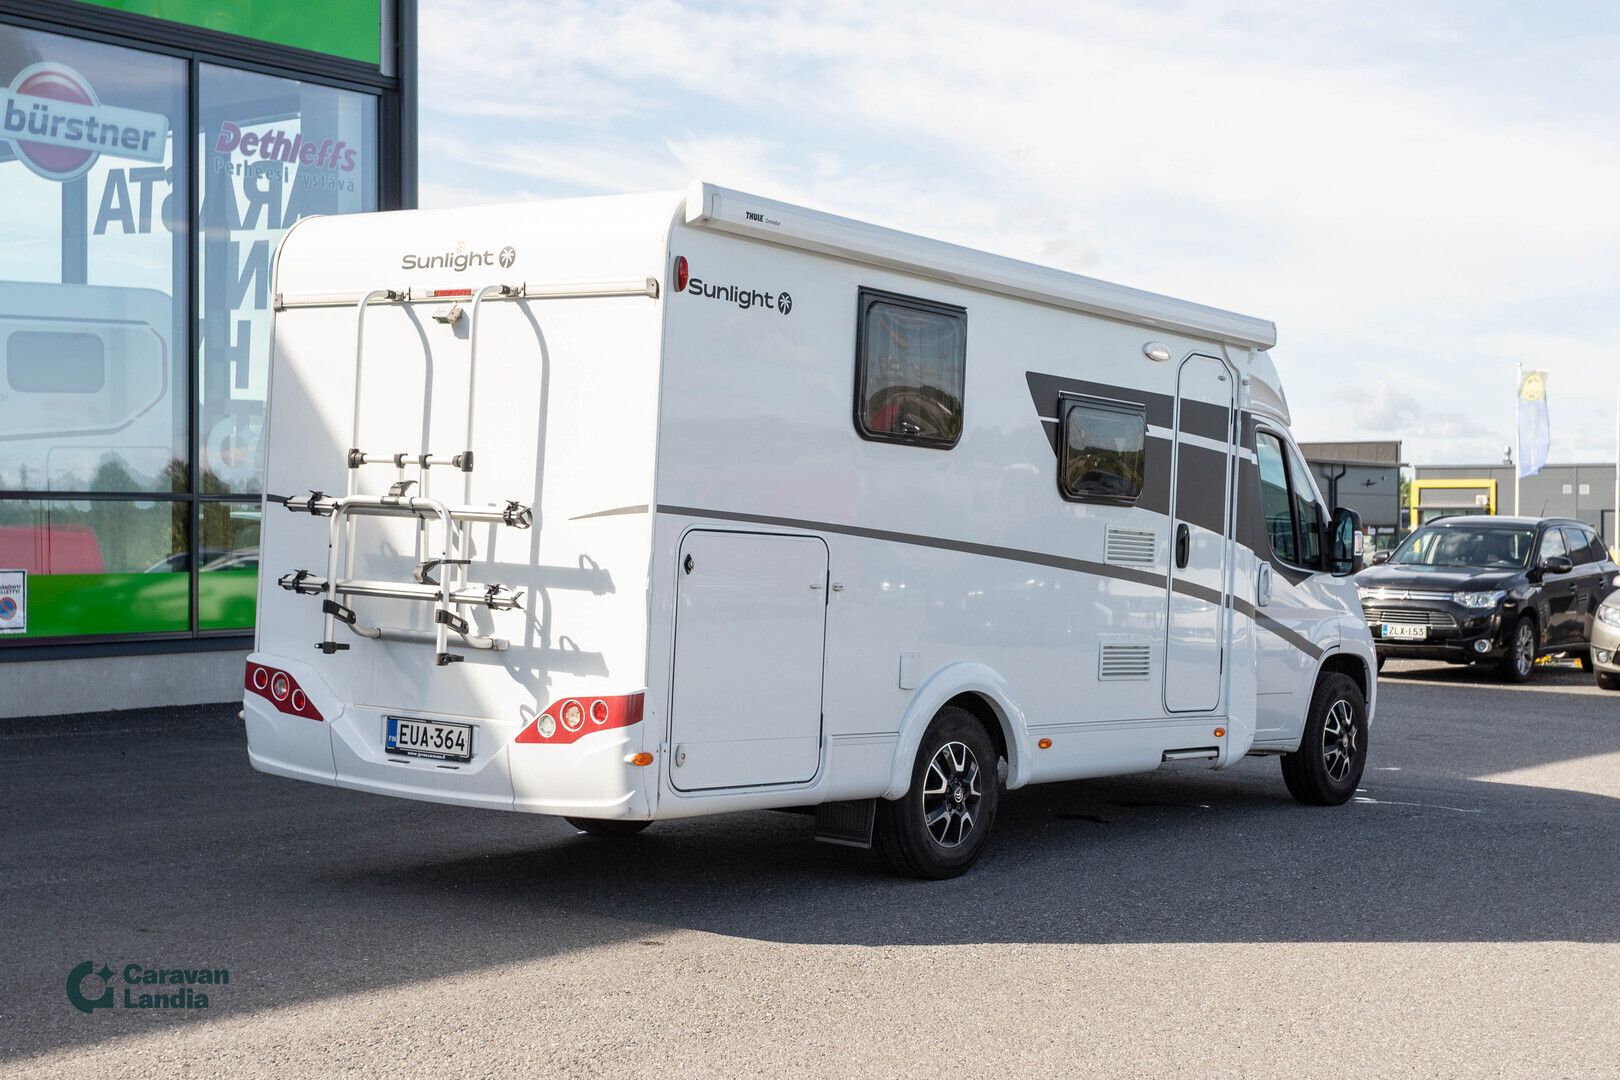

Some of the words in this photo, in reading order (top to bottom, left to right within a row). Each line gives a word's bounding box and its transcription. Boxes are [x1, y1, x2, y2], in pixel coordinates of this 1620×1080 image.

[4, 98, 156, 151] bürstner
[215, 121, 358, 171] Dethleffs
[745, 211, 764, 223] THULE
[401, 250, 494, 272] Sunlight
[688, 278, 774, 309] Sunlight
[399, 723, 465, 752] EUA-364
